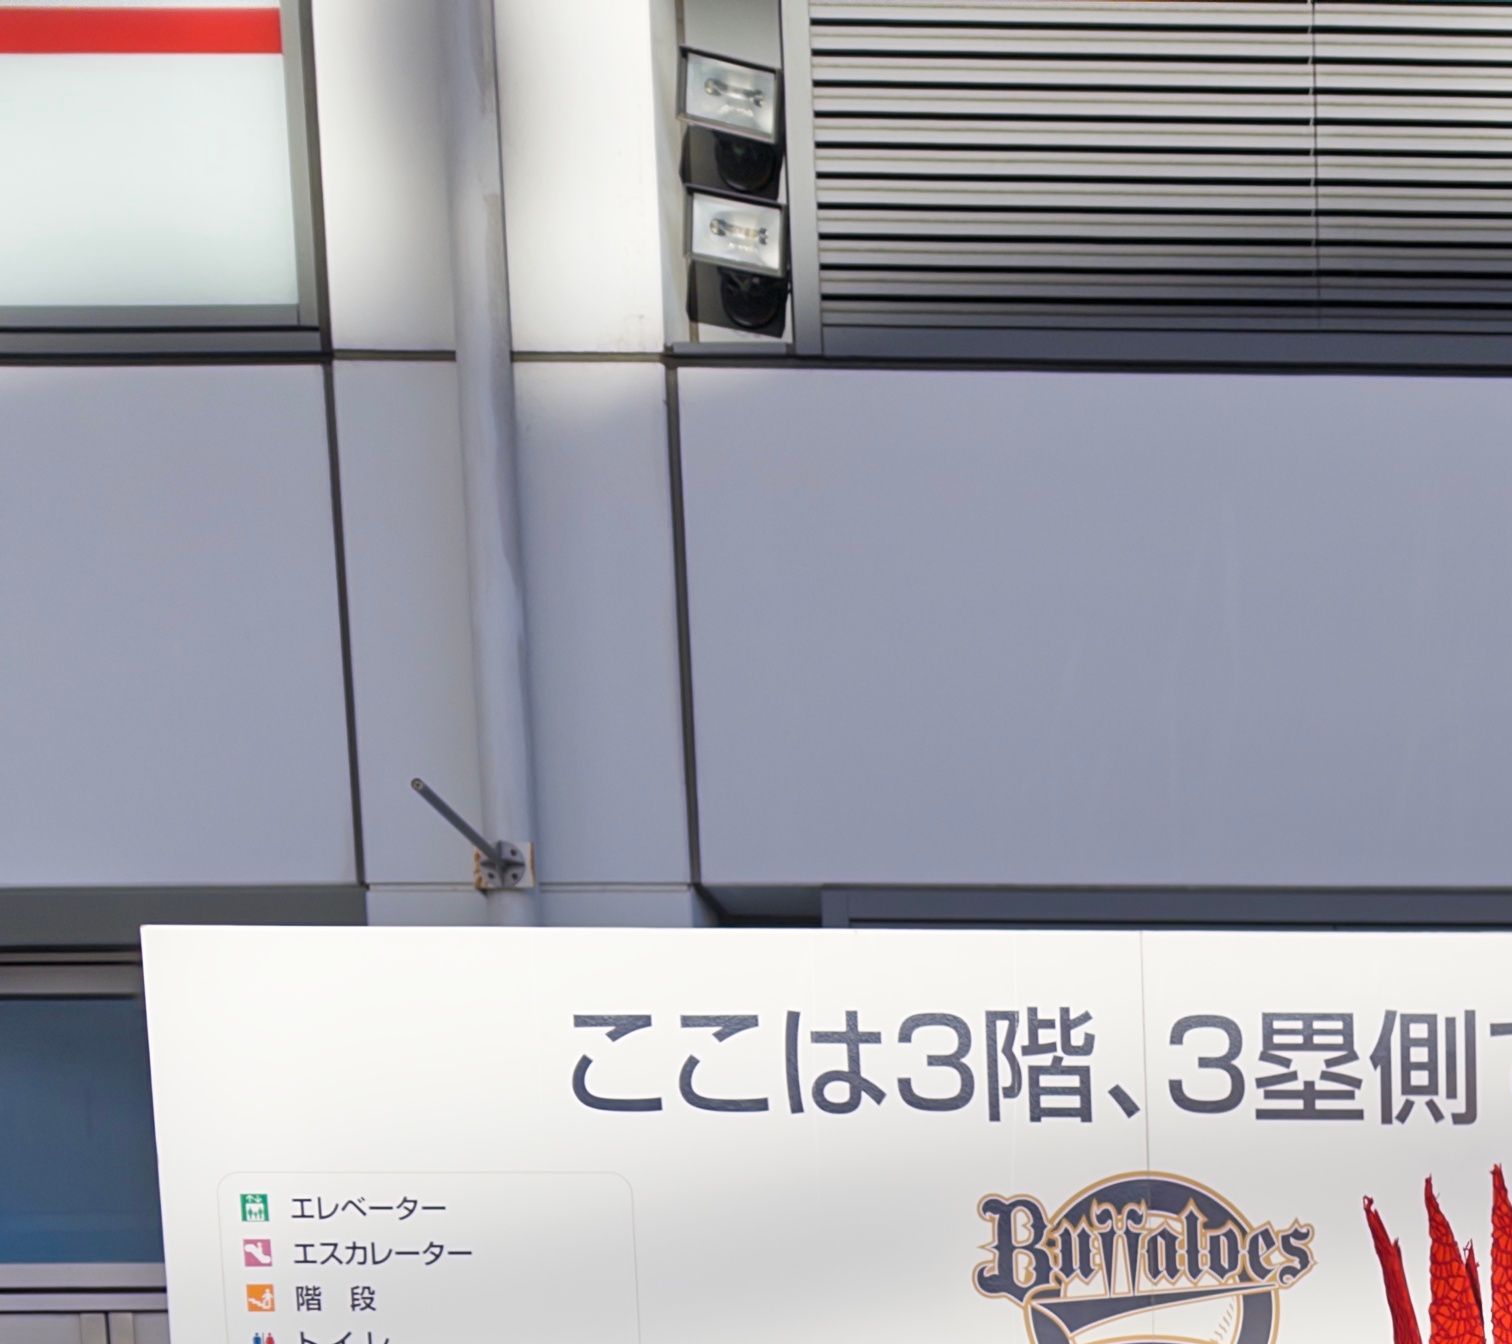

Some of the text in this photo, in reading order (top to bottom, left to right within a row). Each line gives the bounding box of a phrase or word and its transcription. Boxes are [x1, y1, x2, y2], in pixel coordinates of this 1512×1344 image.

[291, 1194, 447, 1221] エレベーター
[293, 1241, 473, 1266] エスカレーター
[973, 1191, 1318, 1303] Buffaloes
